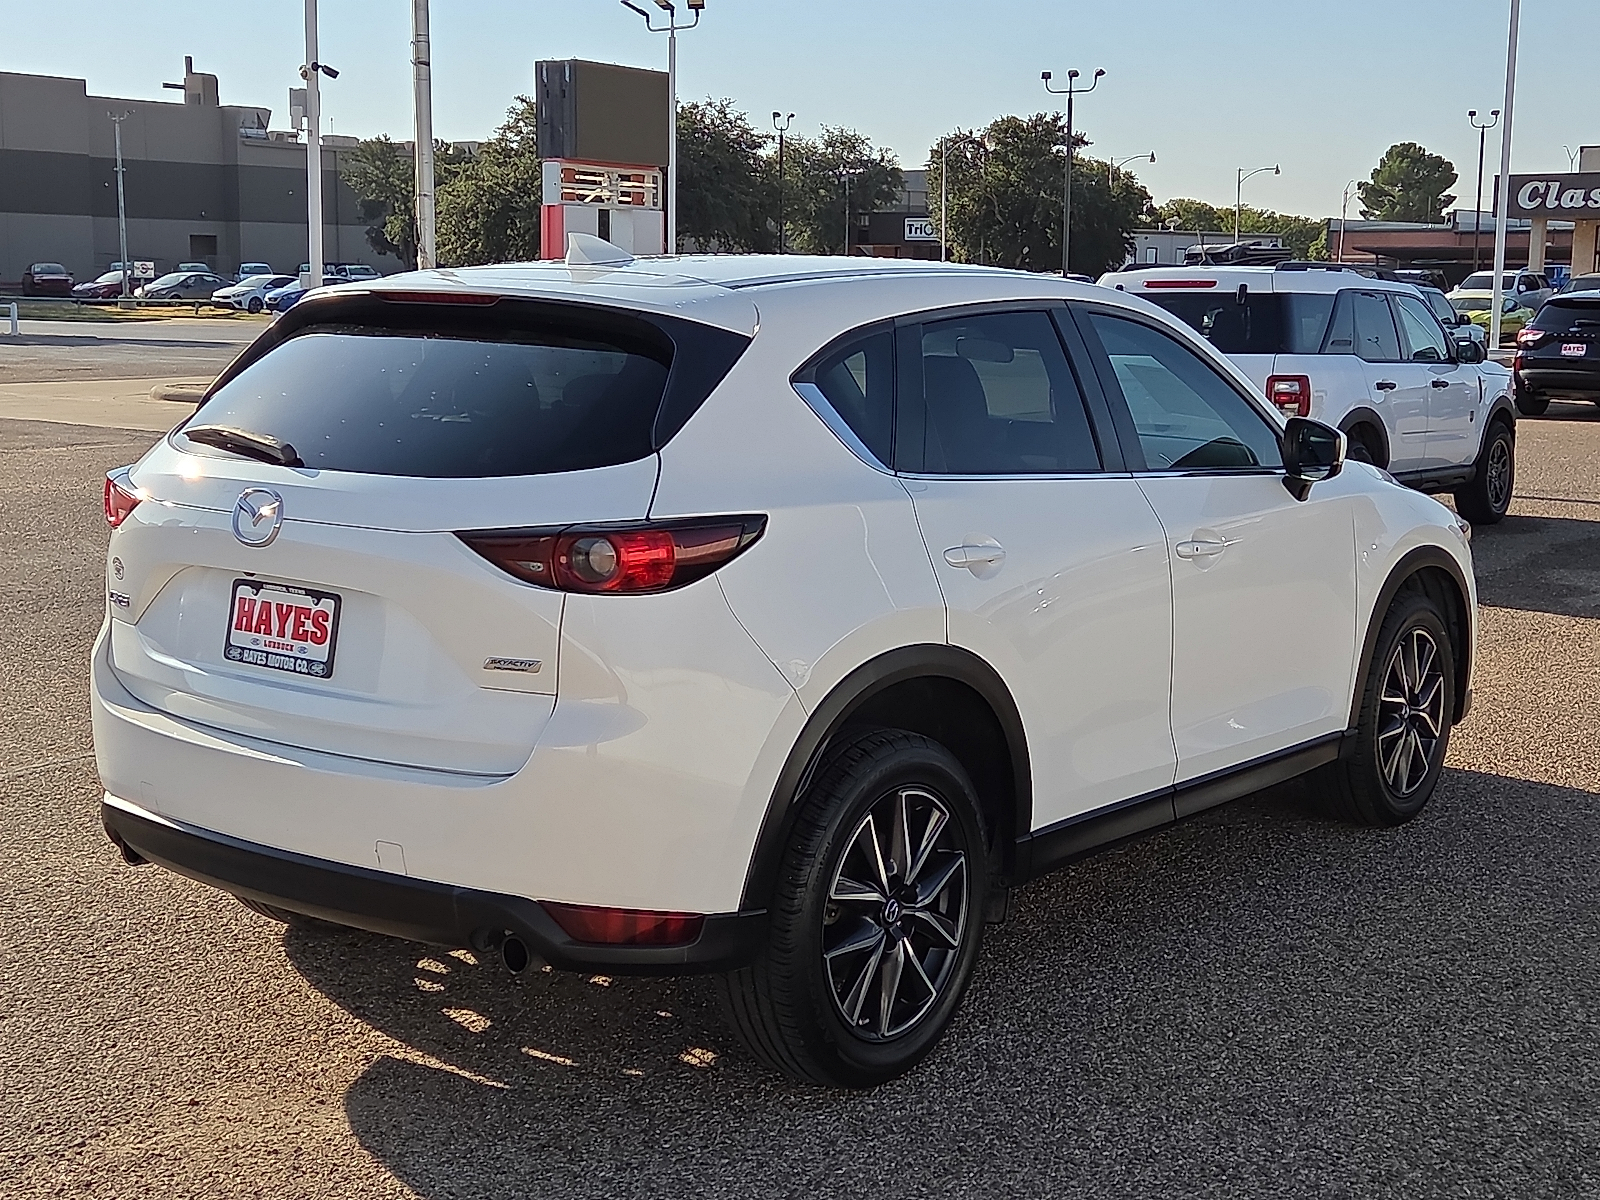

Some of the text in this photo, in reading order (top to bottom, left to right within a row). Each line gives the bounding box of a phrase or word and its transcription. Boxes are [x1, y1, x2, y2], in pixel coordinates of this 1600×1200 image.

[1517, 181, 1600, 209] Clas
[234, 596, 330, 646] HAYES
[243, 649, 267, 665] HAYES
[267, 653, 295, 671] MOTOR
[490, 658, 535, 668] SKYACTIV
